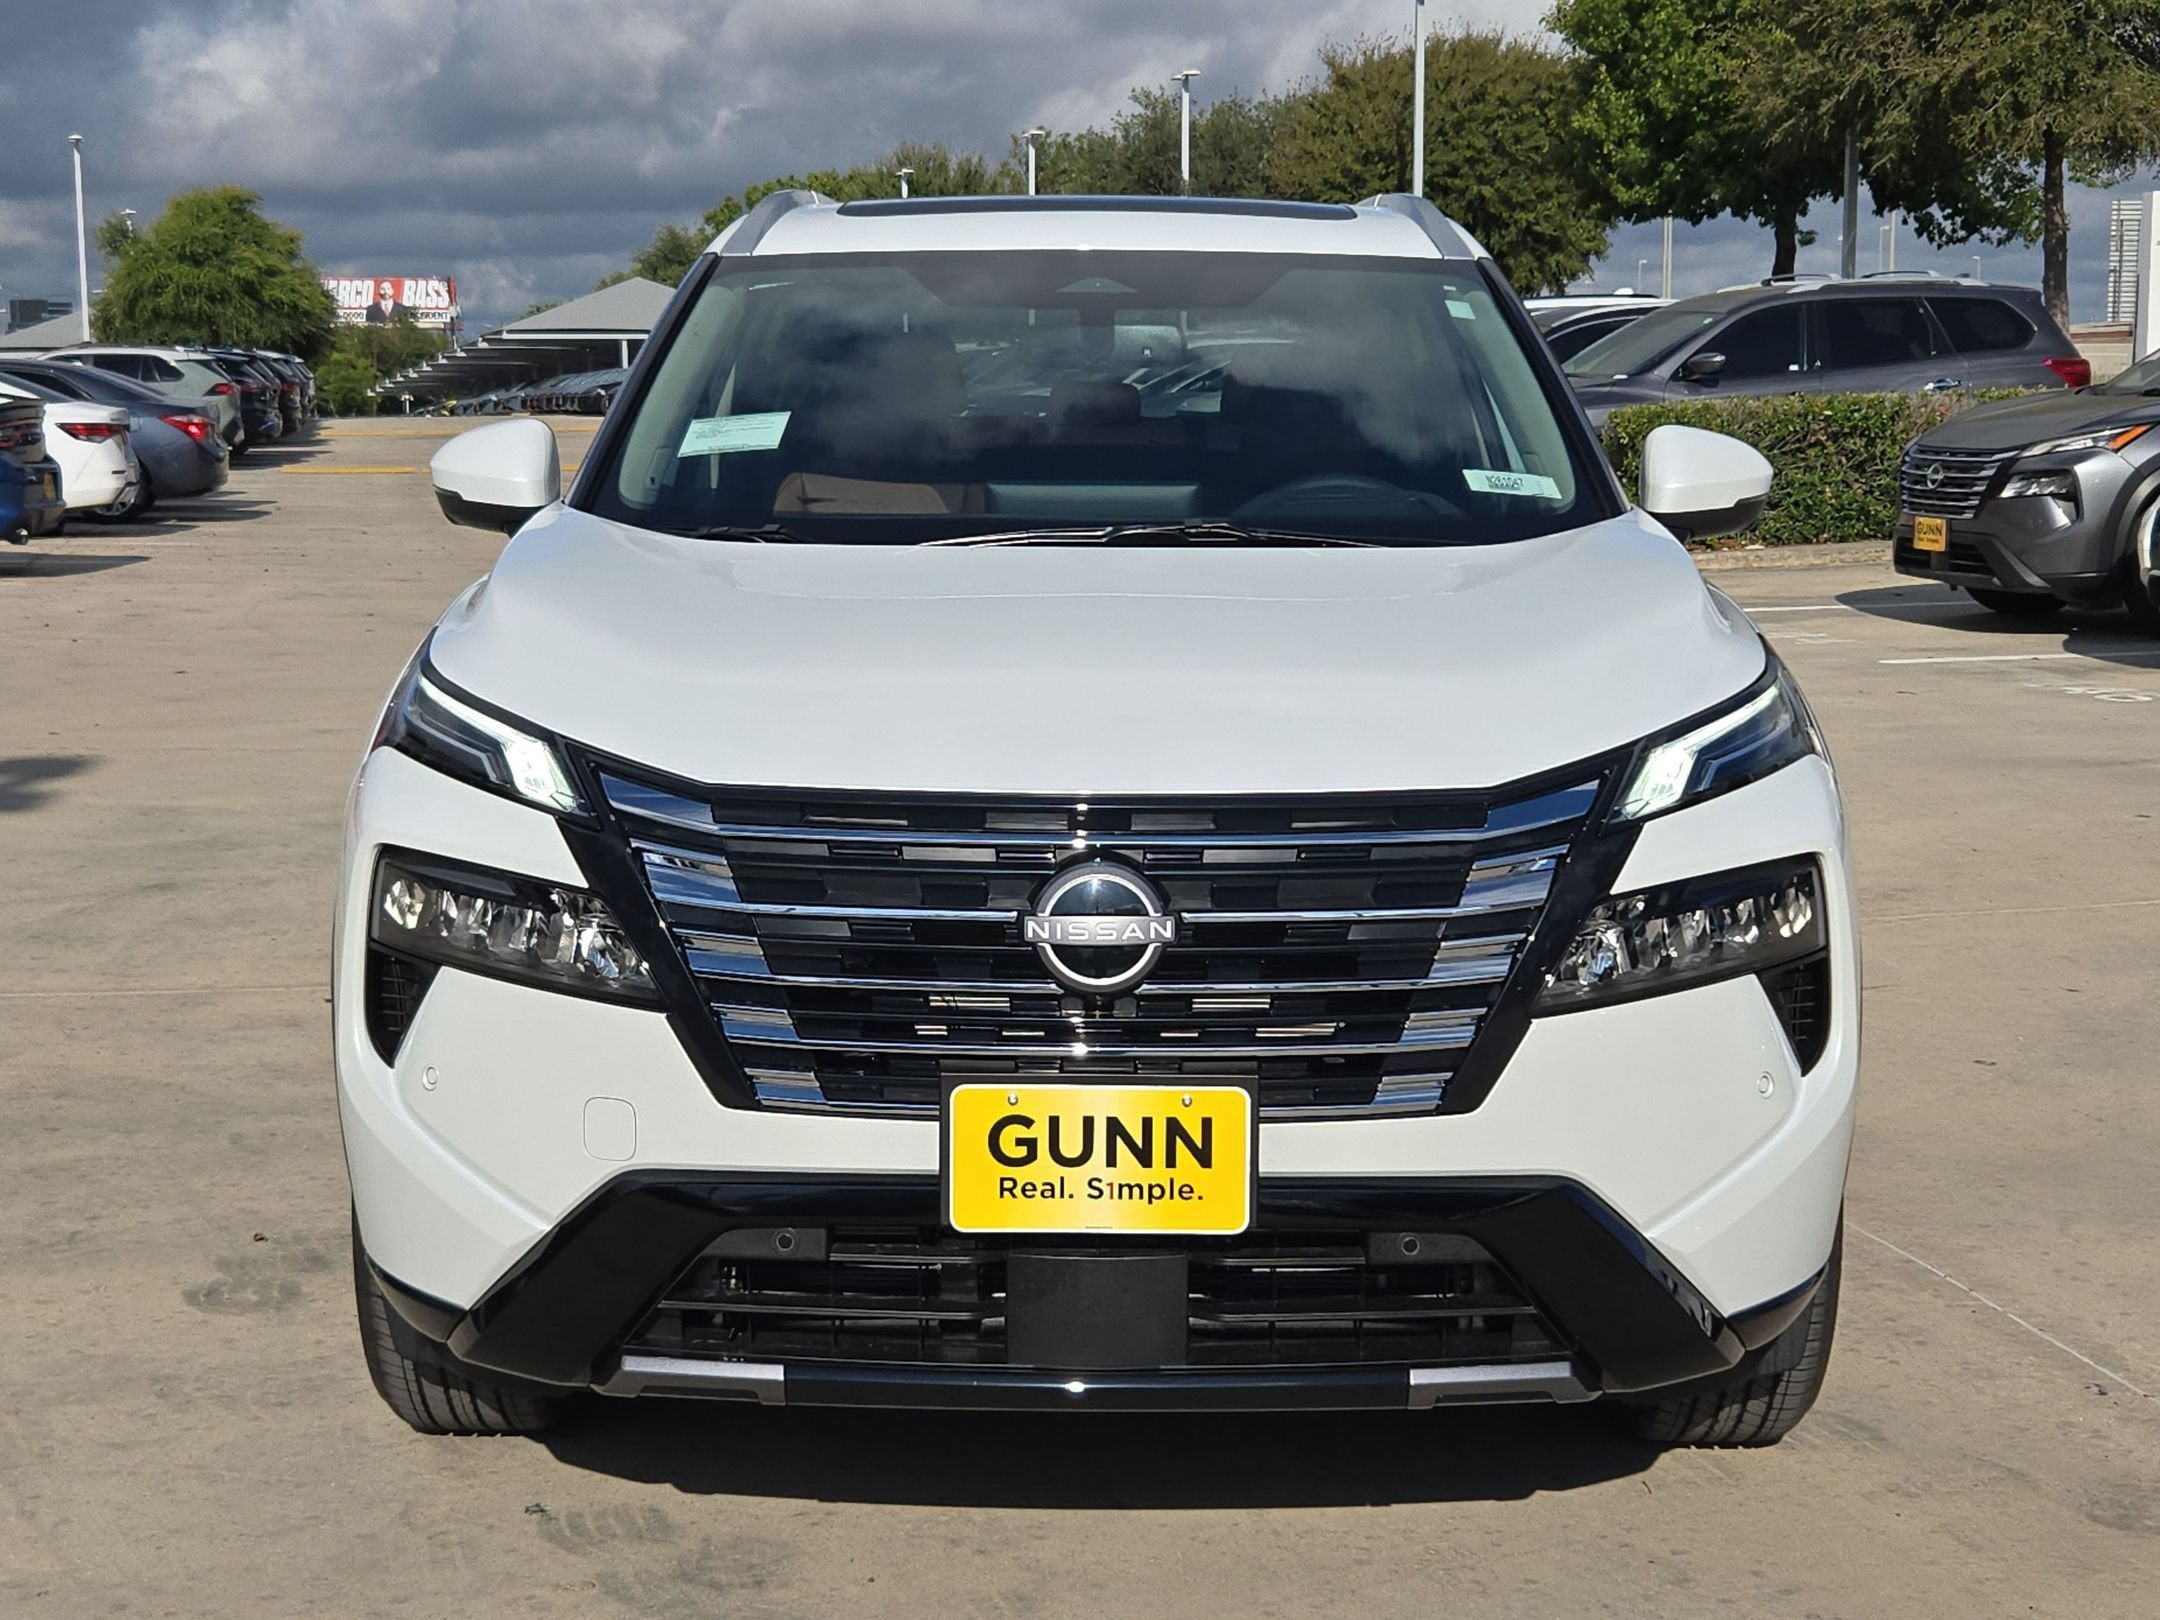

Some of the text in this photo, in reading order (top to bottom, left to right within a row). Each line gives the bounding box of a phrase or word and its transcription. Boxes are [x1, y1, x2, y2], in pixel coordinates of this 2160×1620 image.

[403, 279, 449, 308] BASS
[1917, 521, 1943, 536] GUNN
[1027, 919, 1172, 940] NISSAN
[987, 1114, 1213, 1169] GUNN
[999, 1176, 1075, 1200] Real.
